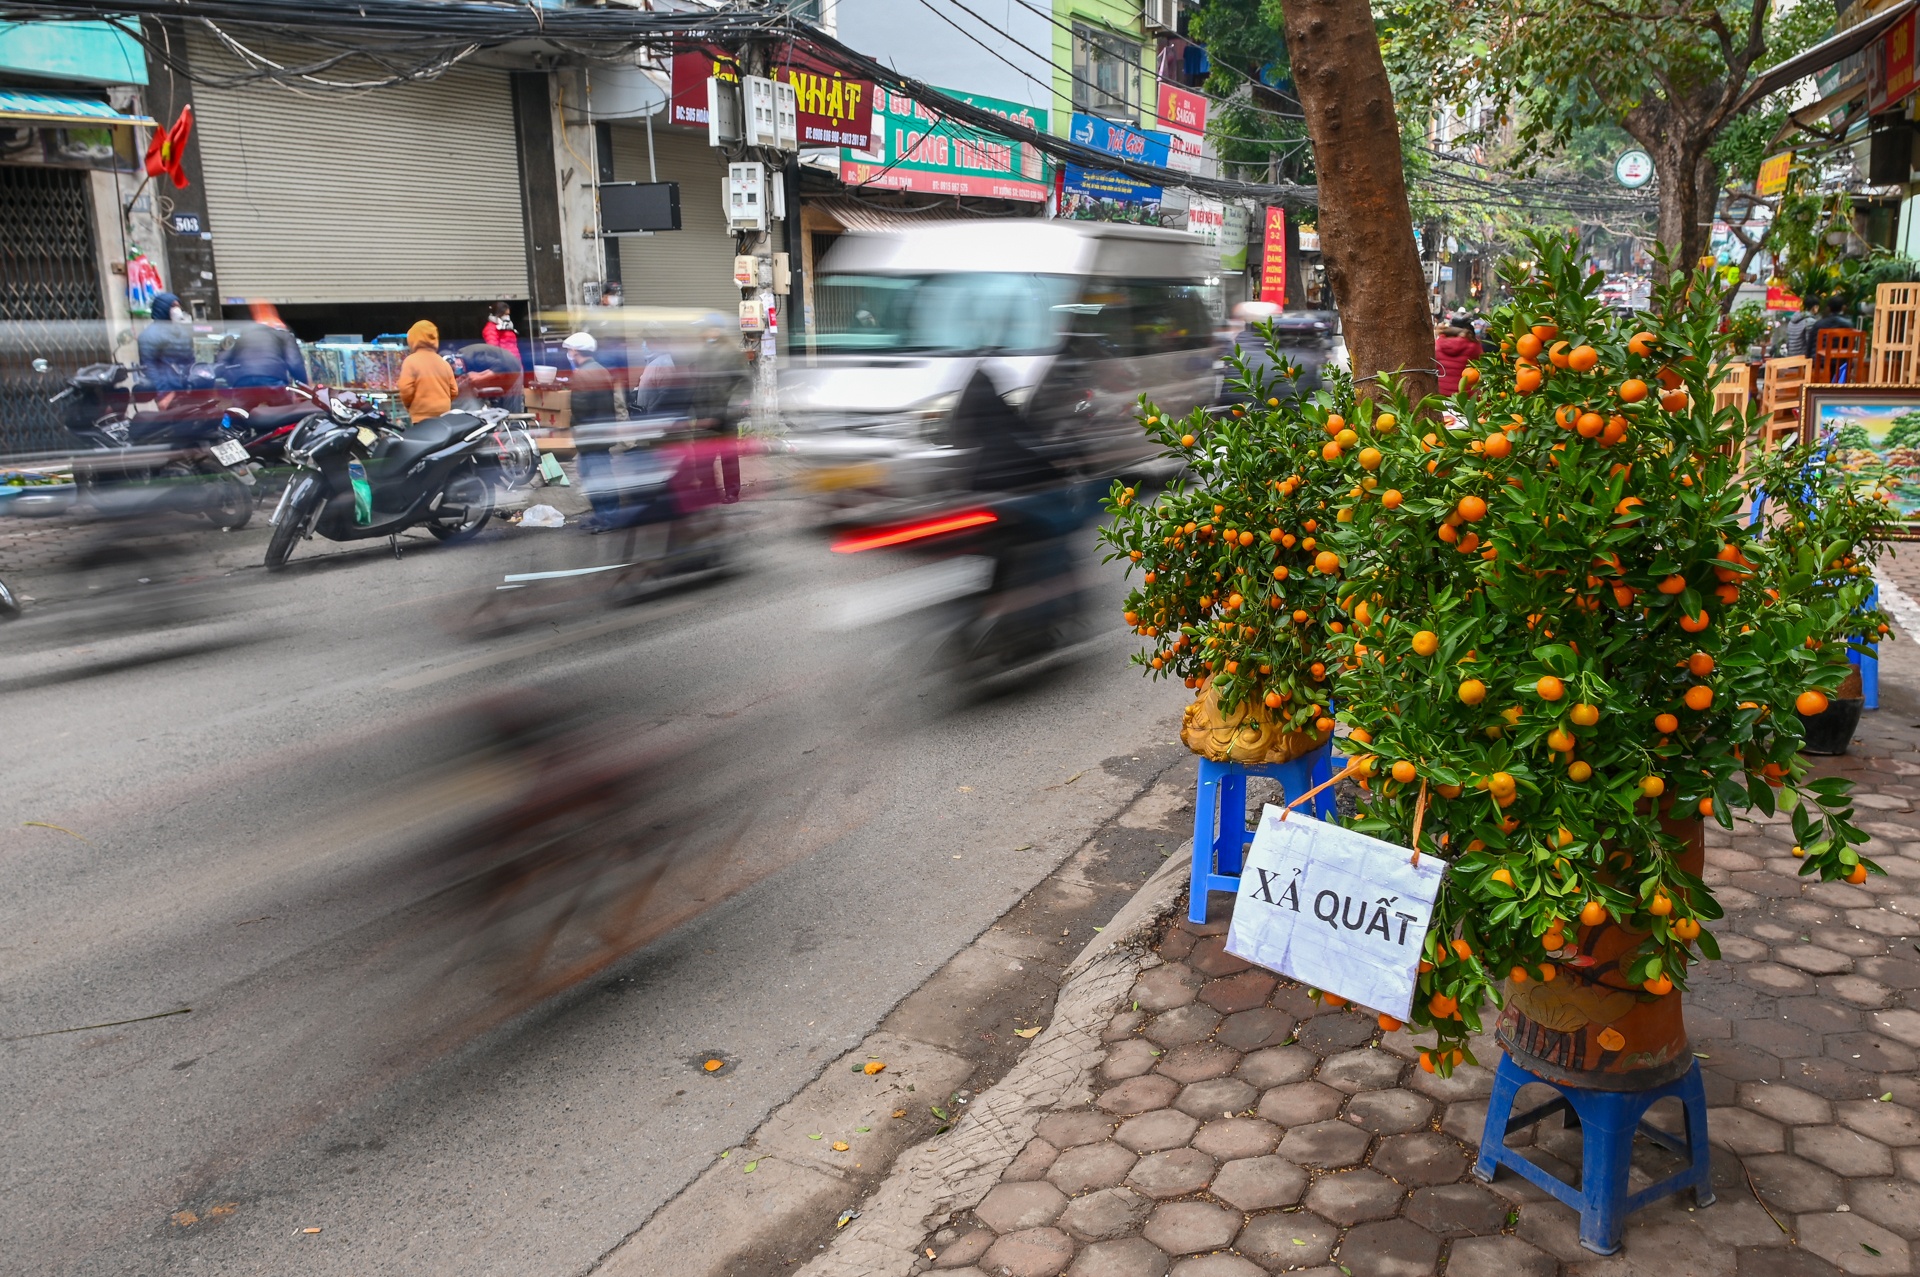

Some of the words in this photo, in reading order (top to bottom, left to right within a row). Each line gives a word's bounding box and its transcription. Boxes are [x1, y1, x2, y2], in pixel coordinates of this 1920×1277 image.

[788, 70, 862, 127] NHẬT
[895, 128, 949, 166] LONG
[952, 136, 1012, 173] THÀNH
[857, 164, 870, 183] 507
[175, 217, 199, 232] 503
[1270, 232, 1280, 240] 3-2
[1249, 866, 1303, 914] XẢ
[1313, 890, 1418, 946] QUẤT
